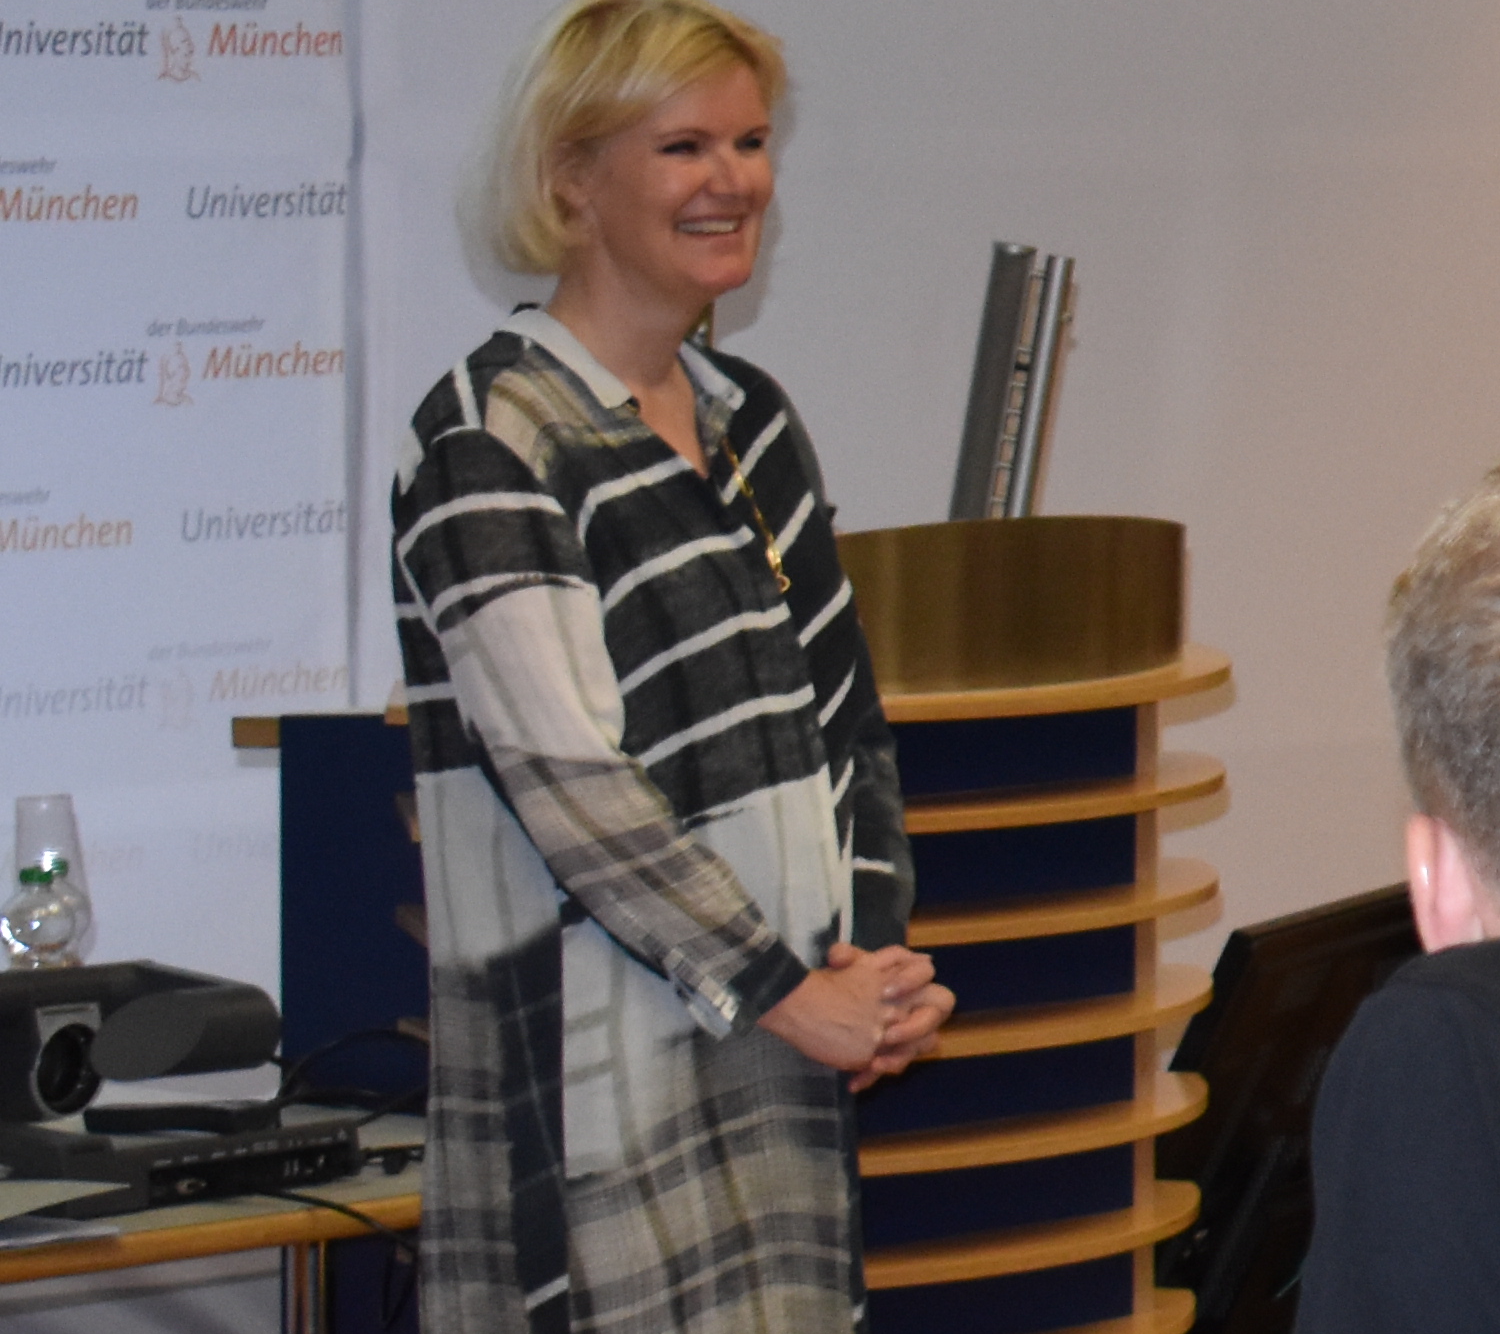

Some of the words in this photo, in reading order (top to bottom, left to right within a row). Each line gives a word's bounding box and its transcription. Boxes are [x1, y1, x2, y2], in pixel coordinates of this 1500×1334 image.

[0, 21, 149, 56] niversität
[208, 22, 342, 56] München
[0, 184, 138, 221] München
[187, 183, 349, 219] Universität
[0, 349, 149, 387] niversität
[203, 340, 344, 378] München
[0, 674, 151, 717] niversität
